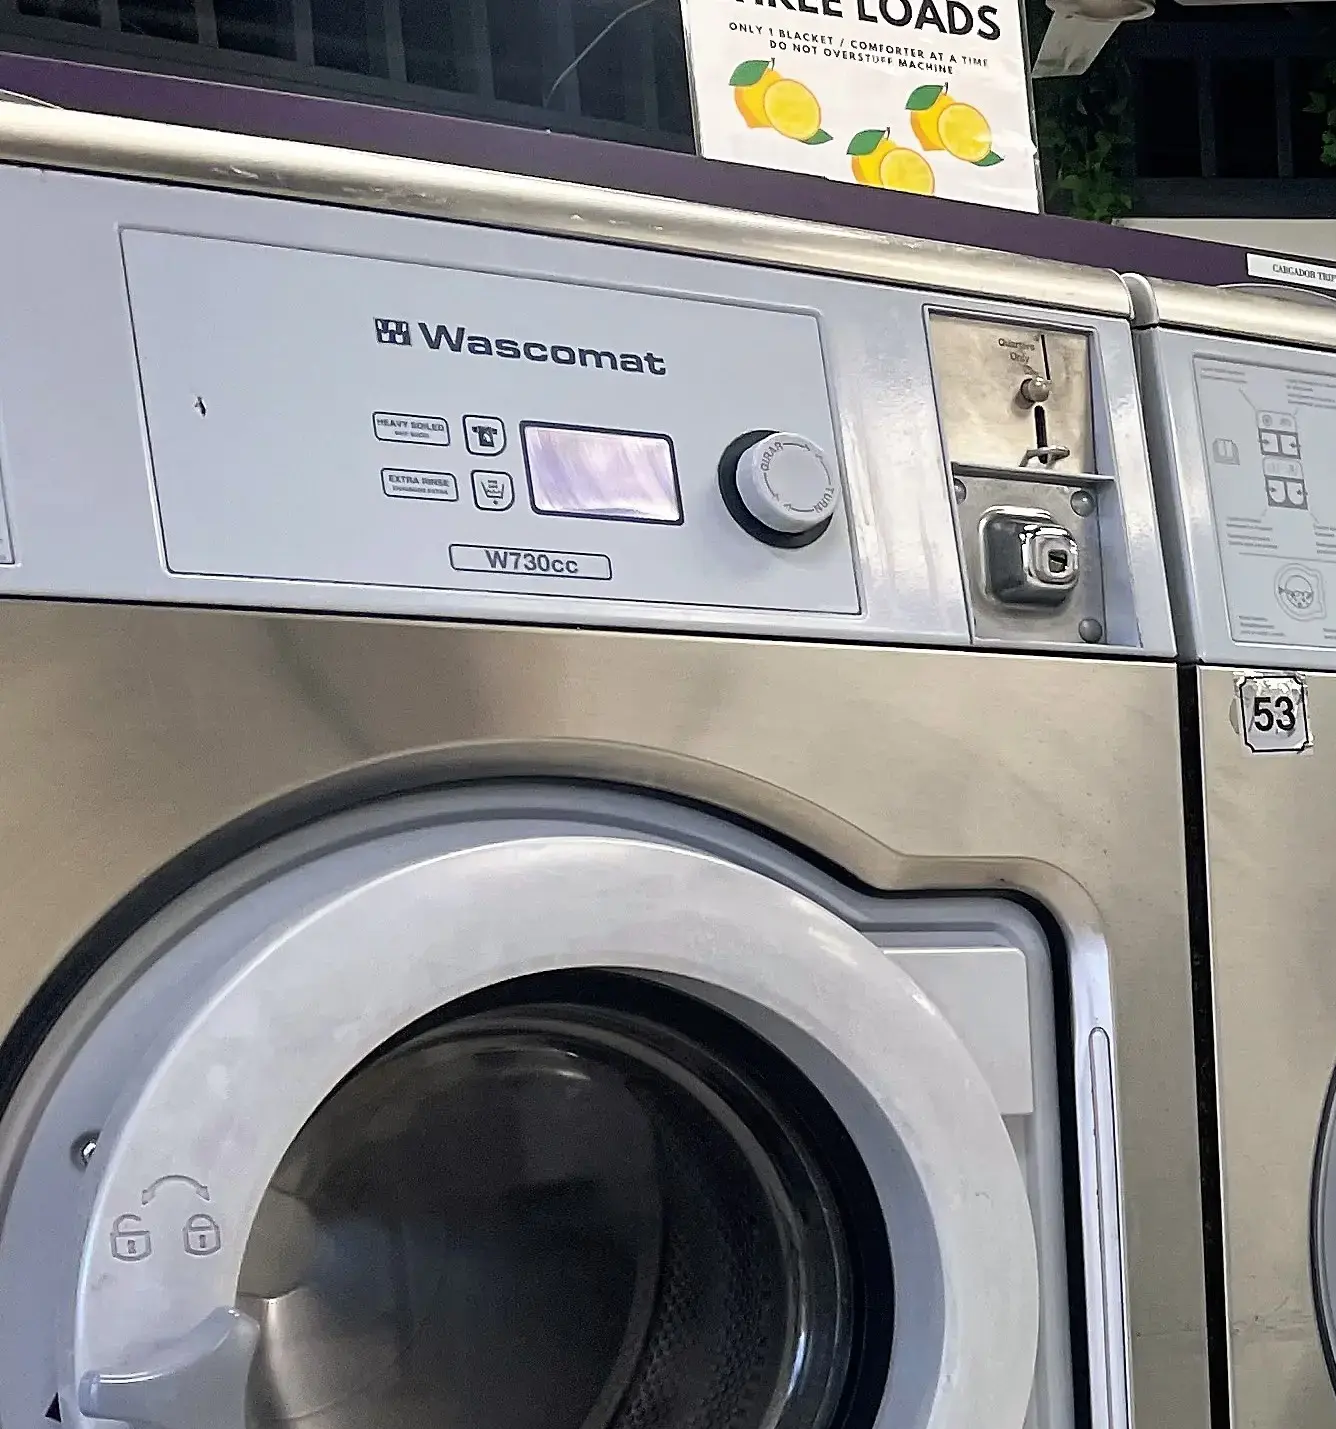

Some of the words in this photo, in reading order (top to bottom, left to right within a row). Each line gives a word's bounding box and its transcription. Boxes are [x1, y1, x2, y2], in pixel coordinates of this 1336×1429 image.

[857, 0, 1001, 41] LOADS
[728, 21, 763, 35] ONLY
[768, 27, 774, 37] 1
[778, 28, 833, 46] BLACKET
[850, 39, 925, 59] COMFORTER
[929, 51, 944, 62] AT
[949, 54, 958, 64] A
[961, 55, 989, 68] TIME
[769, 39, 787, 51] DO
[792, 42, 818, 55] NOT
[898, 58, 954, 75] MACHINE
[417, 321, 667, 376] Wascomat
[376, 418, 408, 428] HEAVY
[760, 441, 784, 472] GIRAR
[388, 474, 420, 484] EXTRA
[813, 486, 835, 514] TURN
[484, 549, 580, 575] W730cc
[1253, 695, 1297, 732] 53
